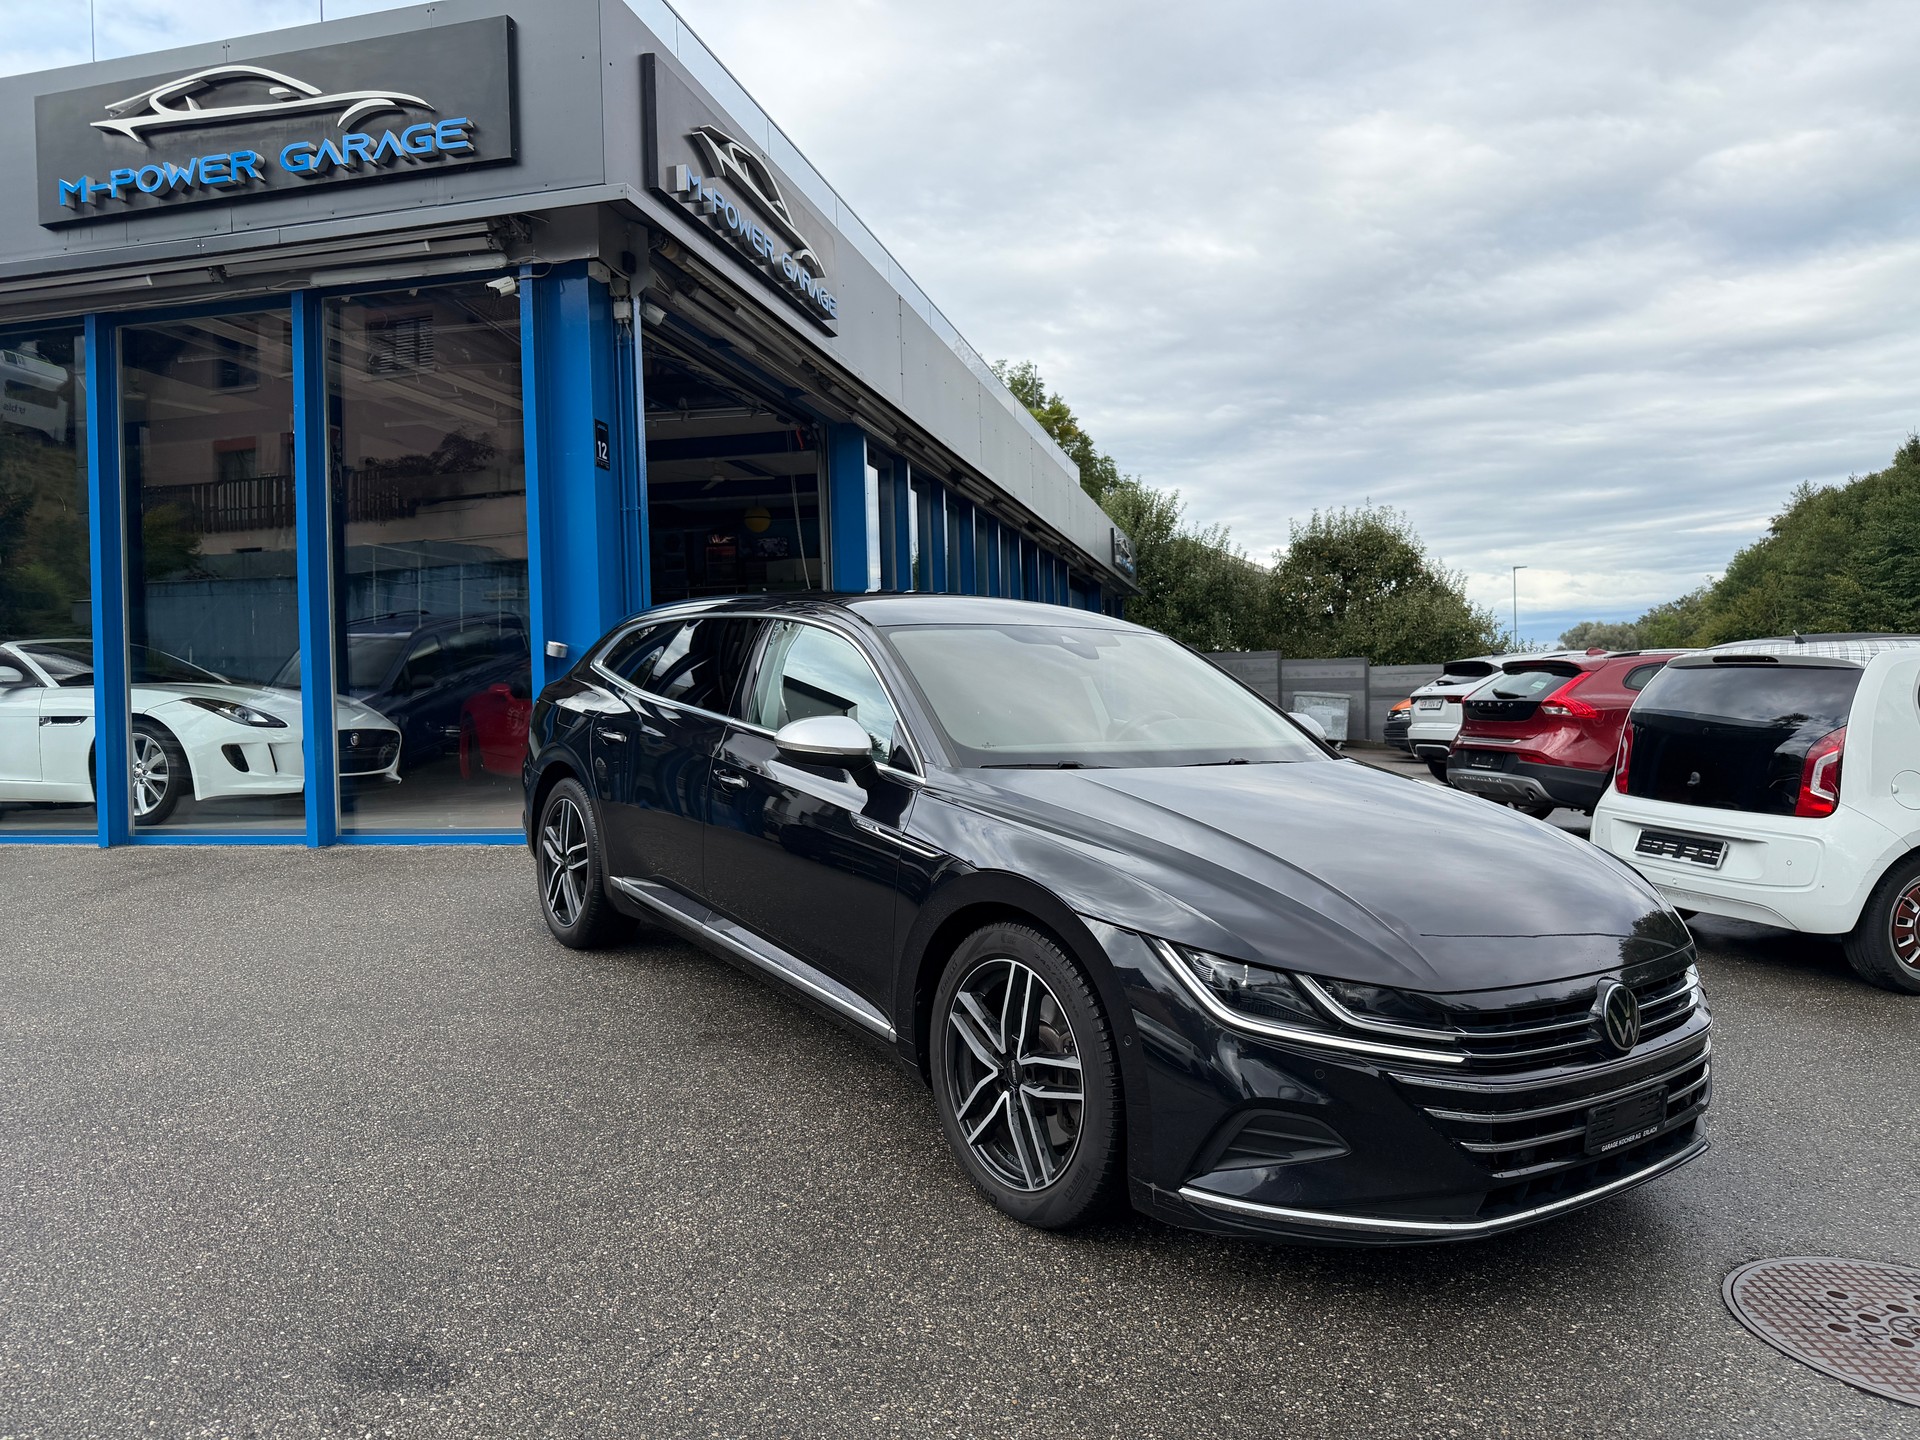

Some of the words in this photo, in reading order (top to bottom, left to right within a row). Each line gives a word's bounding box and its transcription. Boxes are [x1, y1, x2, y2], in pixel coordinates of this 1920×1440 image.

[58, 149, 263, 208] M-POWER
[279, 116, 471, 176] GARAGE
[683, 164, 775, 265] M-POWER
[781, 252, 838, 319] GARAGE
[597, 440, 608, 460] 12
[1601, 1140, 1619, 1152] GARAGE
